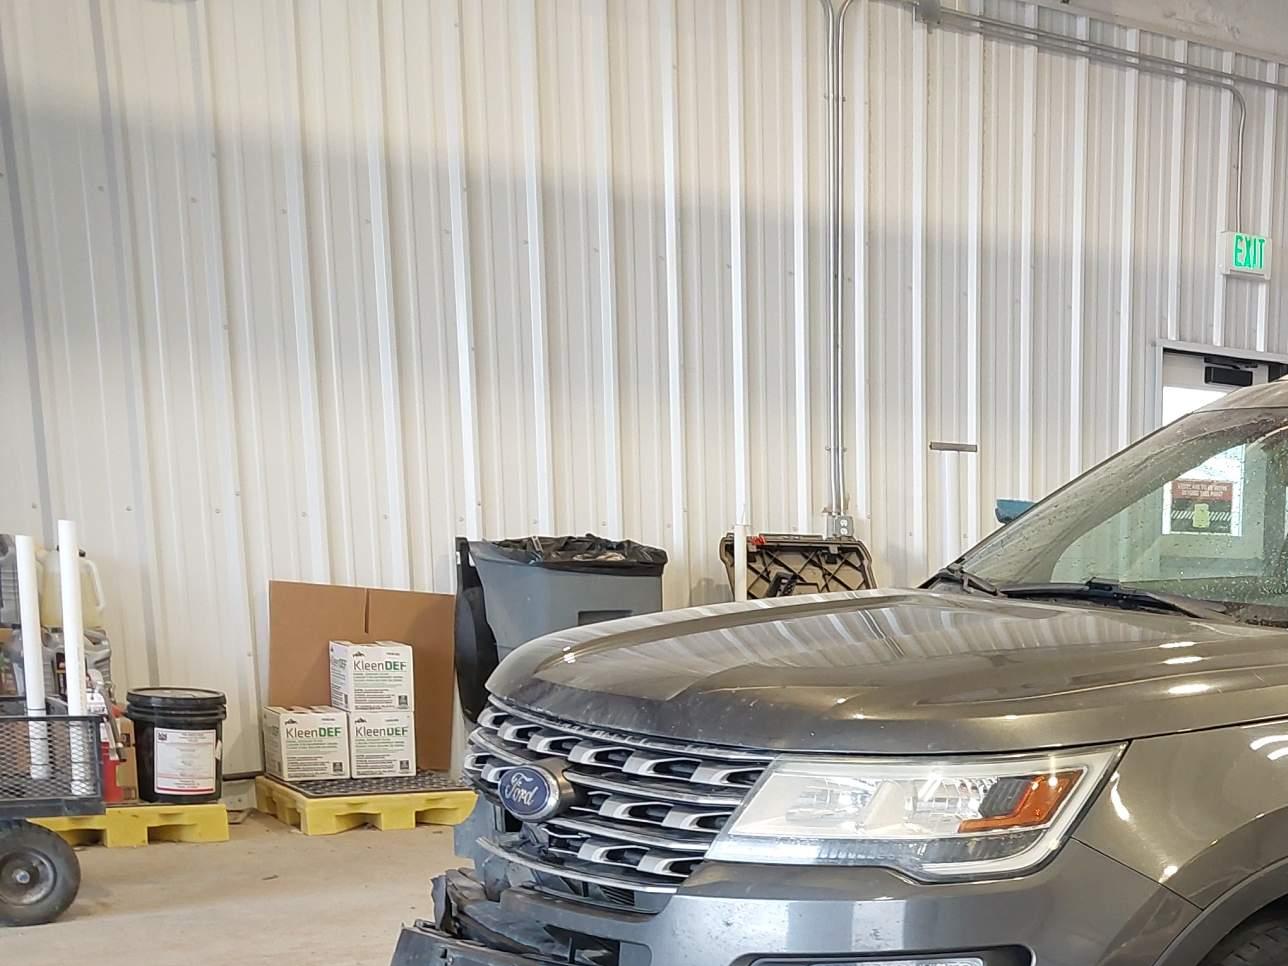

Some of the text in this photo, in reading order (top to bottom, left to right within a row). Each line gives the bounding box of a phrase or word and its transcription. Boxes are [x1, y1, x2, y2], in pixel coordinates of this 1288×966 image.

[1235, 235, 1266, 269] EXIT
[353, 660, 407, 671] KleenDEF
[286, 727, 342, 738] KleenDEF
[355, 726, 408, 737] KleenDEF
[504, 772, 539, 806] Ford
